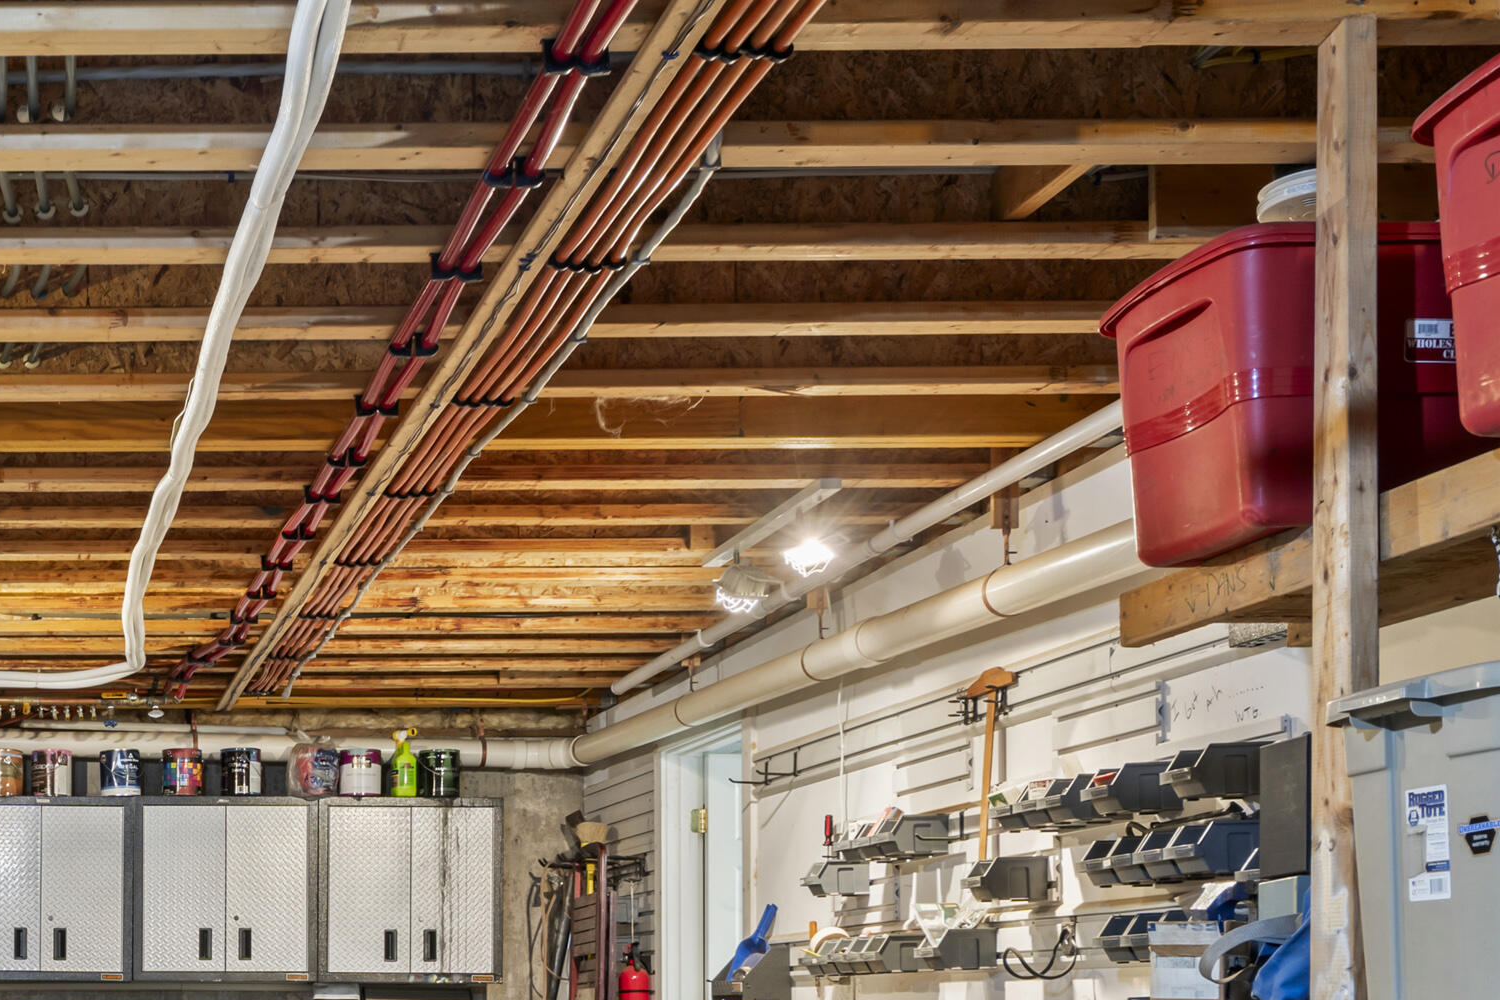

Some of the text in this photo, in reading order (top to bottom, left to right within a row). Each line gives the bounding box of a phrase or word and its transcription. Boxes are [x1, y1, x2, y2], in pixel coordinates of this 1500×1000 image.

[1407, 339, 1455, 348] WHOLES
[1408, 790, 1445, 807] RUGGED
[1419, 803, 1446, 818] TOTE
